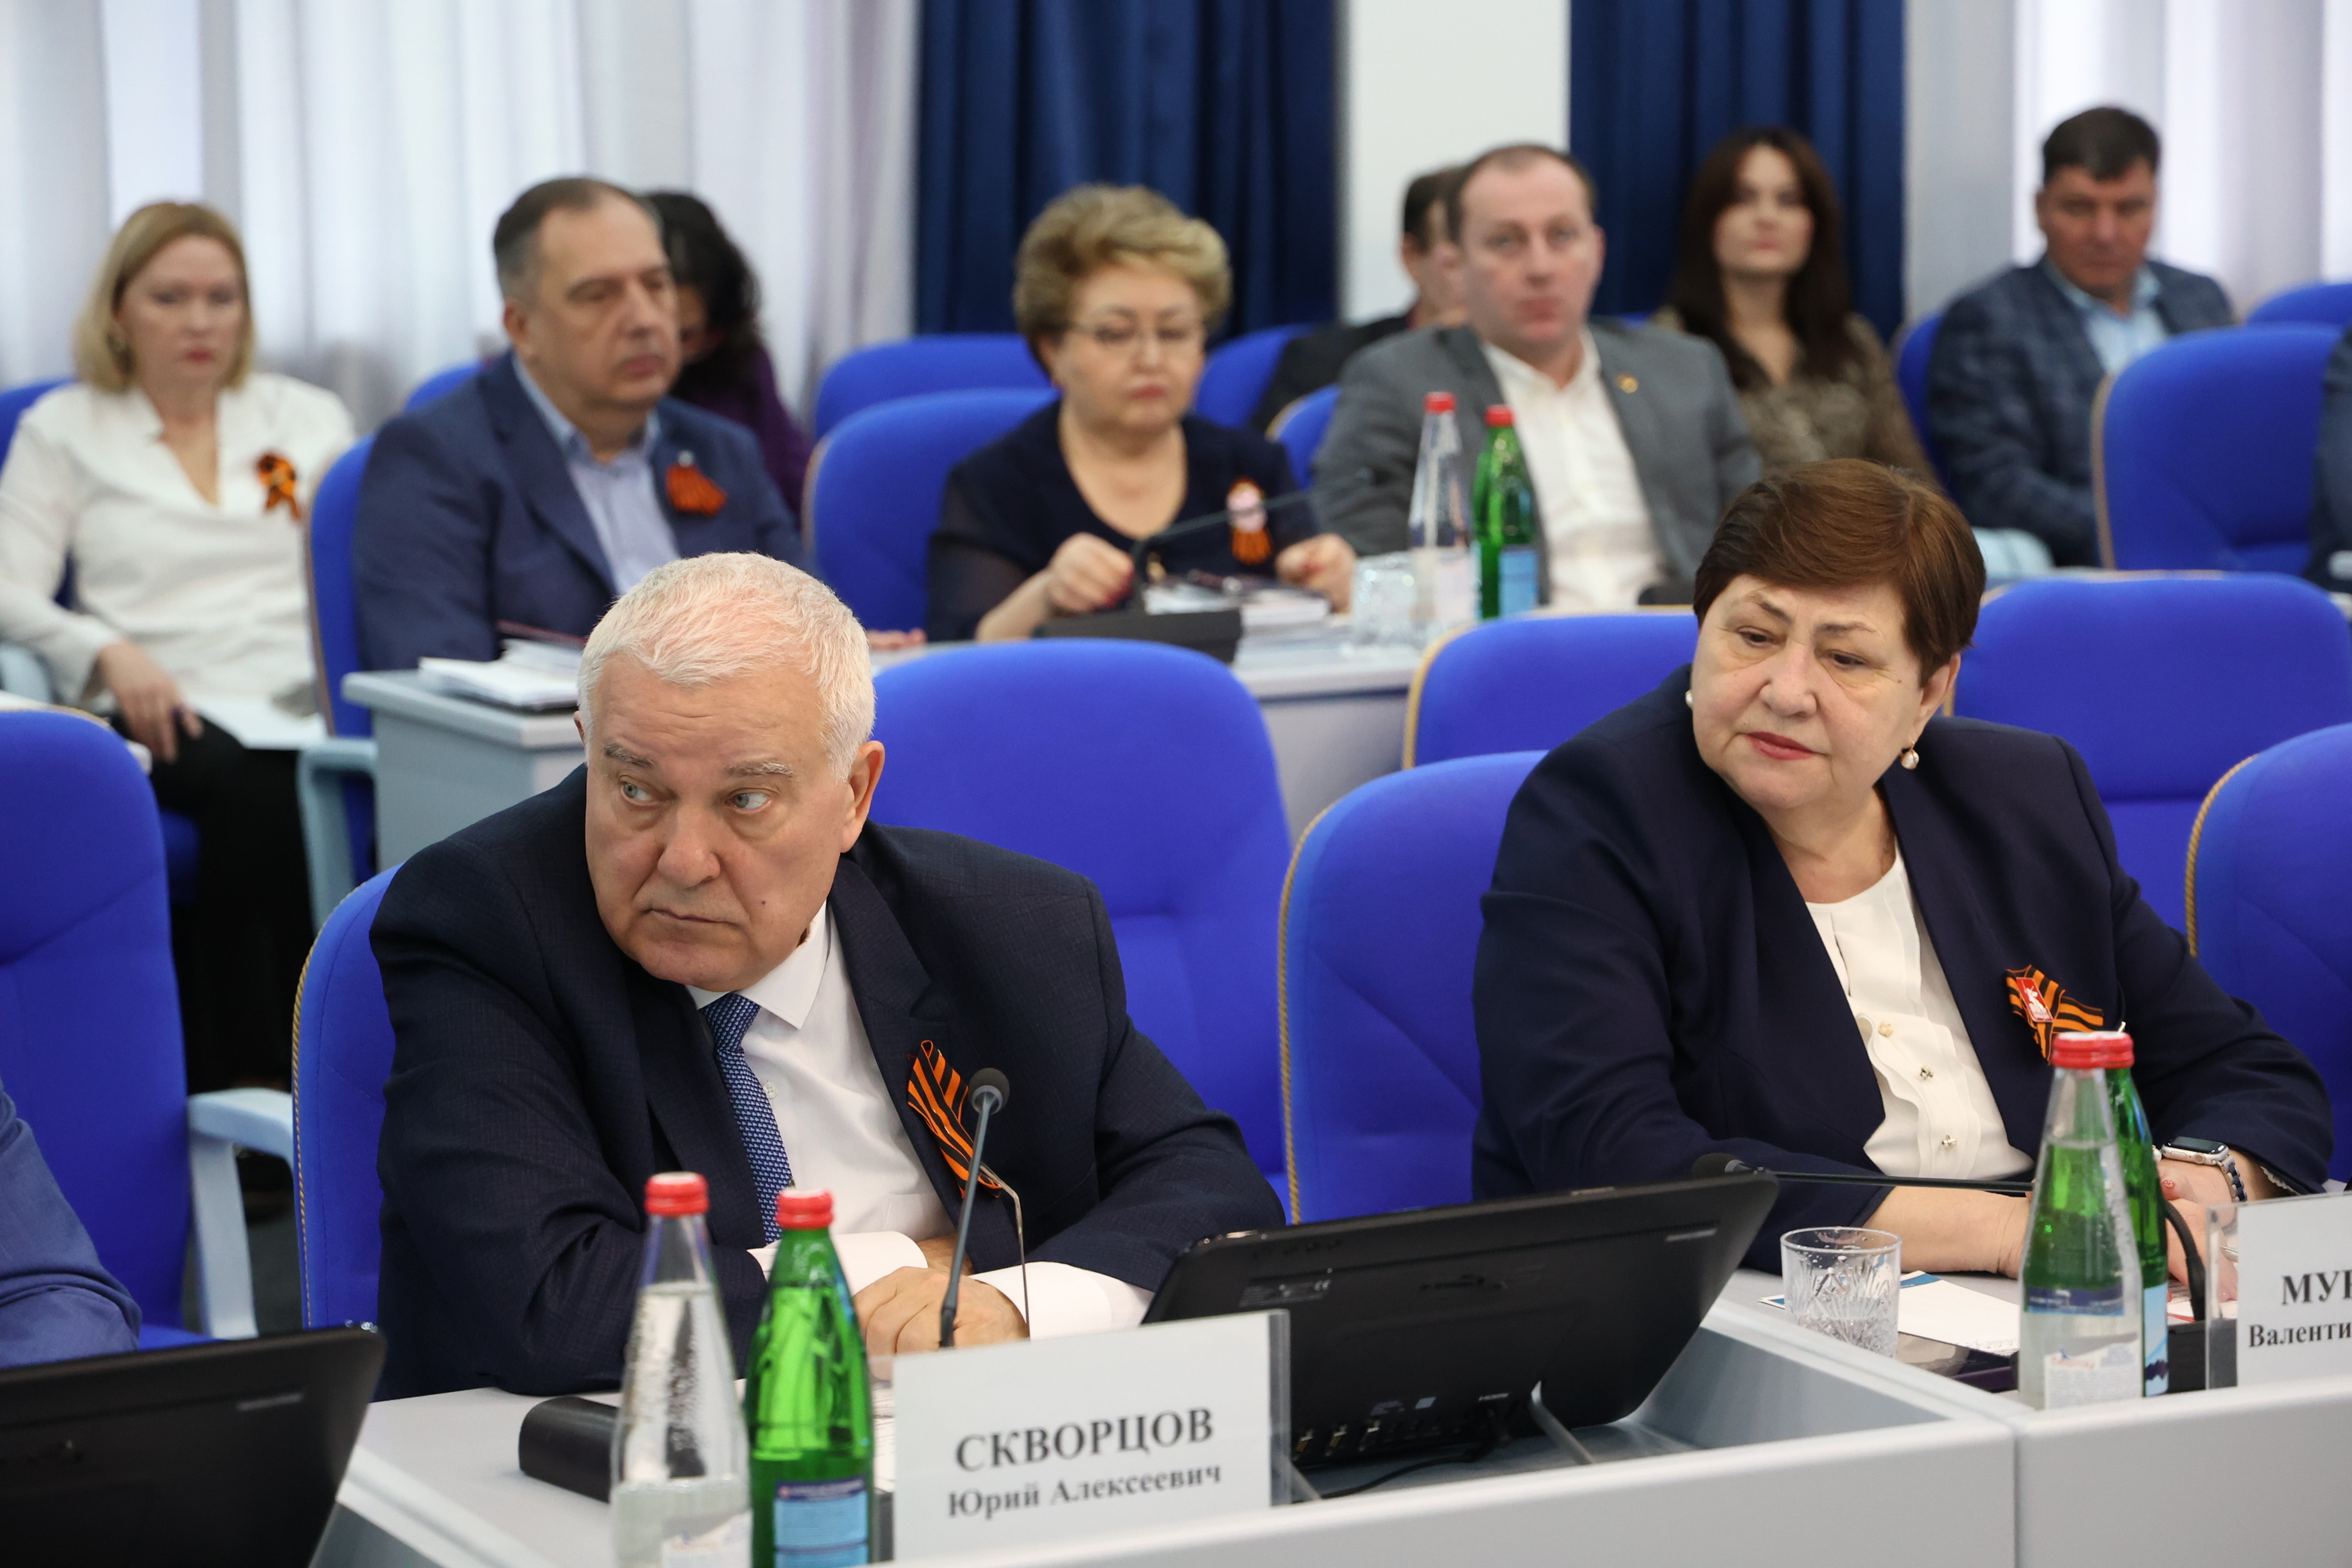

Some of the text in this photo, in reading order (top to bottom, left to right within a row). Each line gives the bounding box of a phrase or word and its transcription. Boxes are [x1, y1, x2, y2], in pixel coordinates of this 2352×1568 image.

[956, 1407, 1213, 1473] СКВОРЦОВ
[948, 1464, 1222, 1520] Юрий Алексеевич
